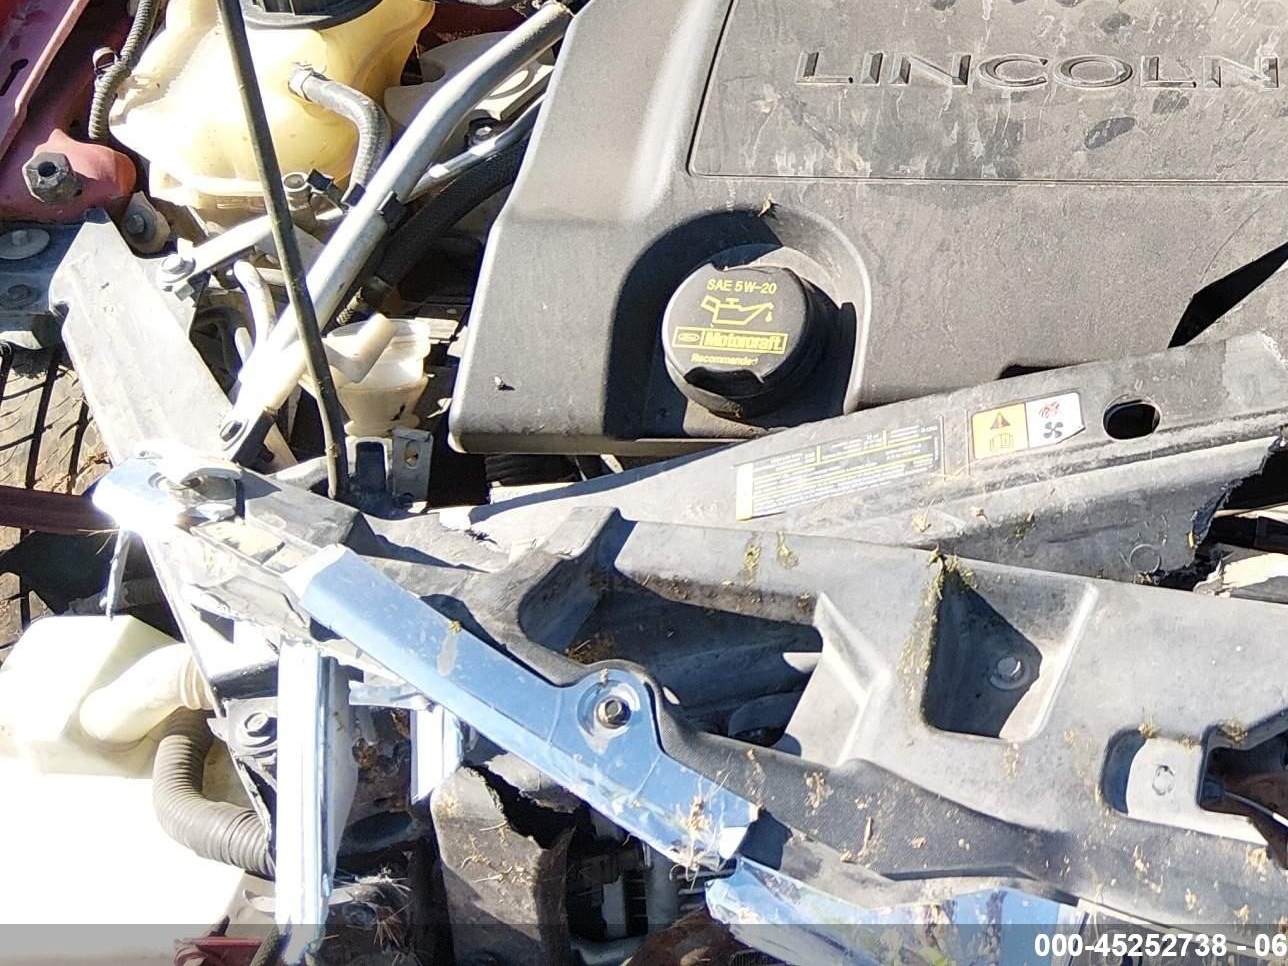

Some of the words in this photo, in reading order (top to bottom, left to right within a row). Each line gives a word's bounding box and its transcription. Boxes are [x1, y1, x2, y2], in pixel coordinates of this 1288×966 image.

[794, 50, 1280, 89] LINCOLN
[706, 278, 733, 292] SAE
[735, 280, 777, 295] 5W-20
